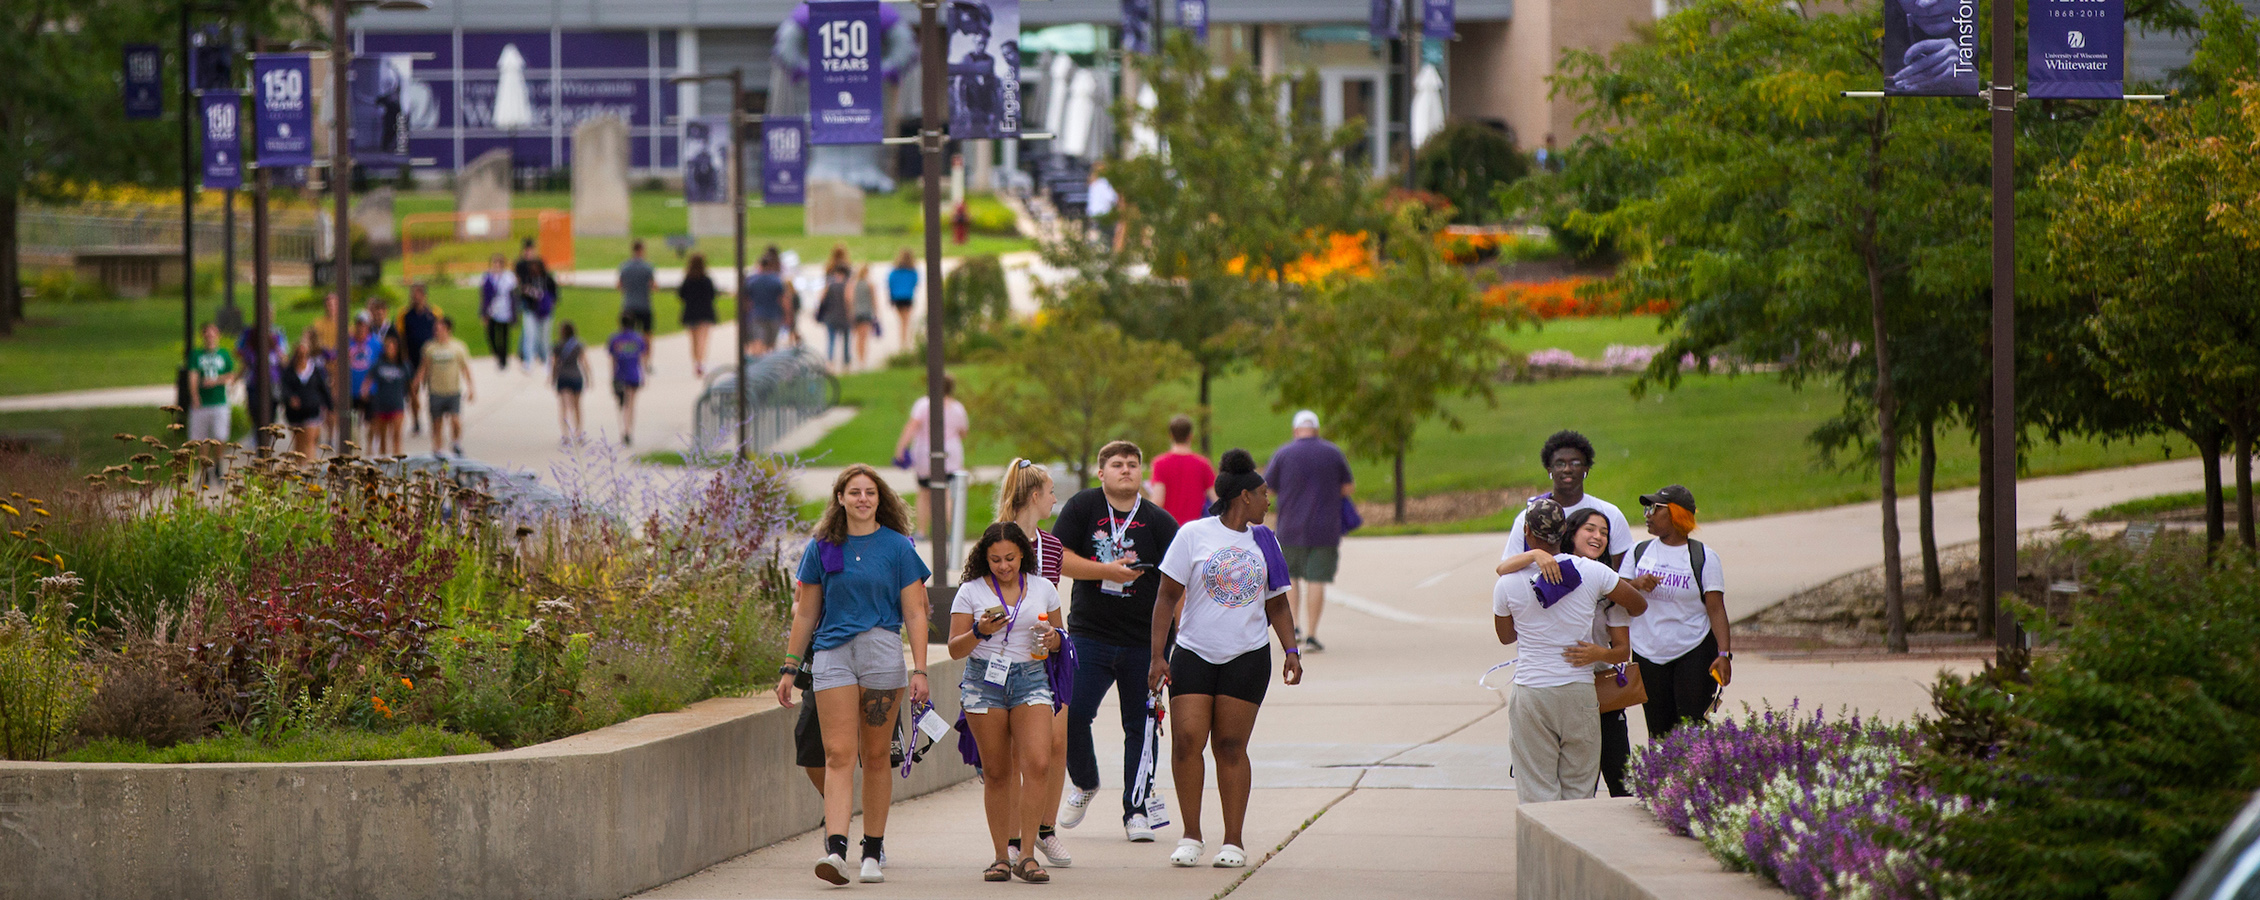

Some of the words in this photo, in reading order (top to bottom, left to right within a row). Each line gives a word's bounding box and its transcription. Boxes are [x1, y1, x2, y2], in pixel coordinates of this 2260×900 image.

[818, 19, 868, 58] 150
[2044, 52, 2072, 61] University
[821, 58, 869, 72] YEARS
[2044, 60, 2108, 70] Whitewater
[262, 69, 303, 99] 150
